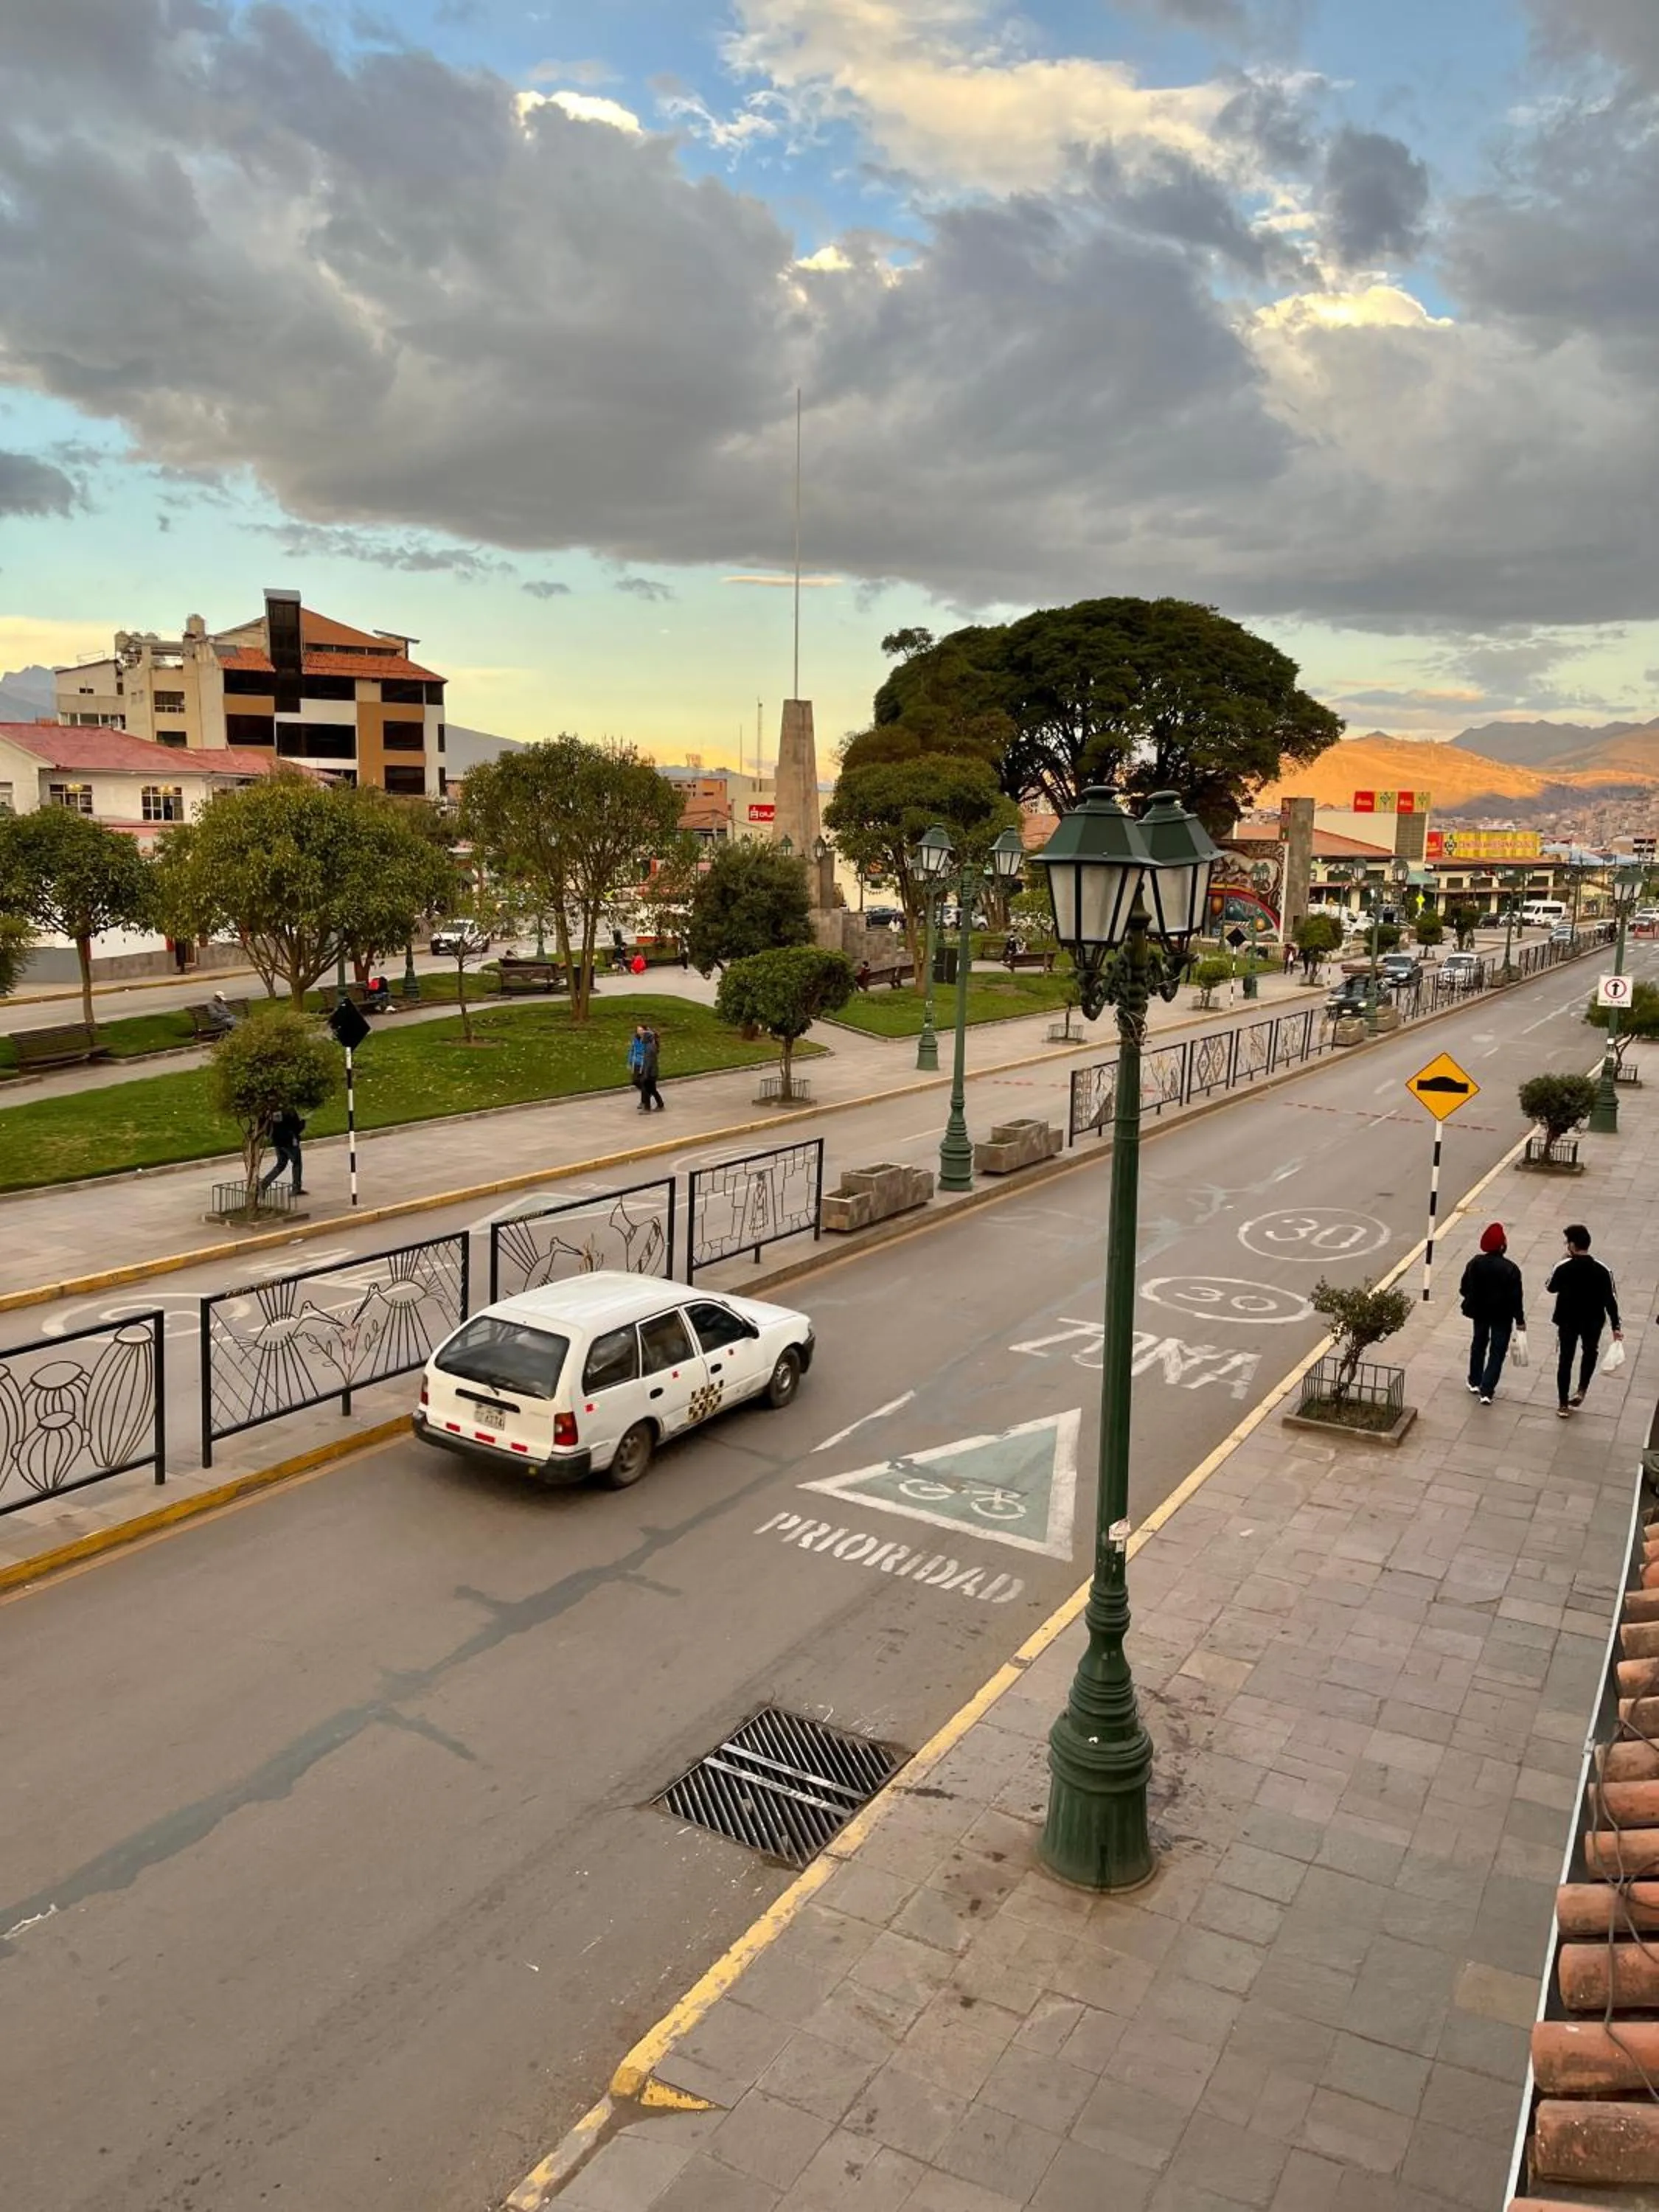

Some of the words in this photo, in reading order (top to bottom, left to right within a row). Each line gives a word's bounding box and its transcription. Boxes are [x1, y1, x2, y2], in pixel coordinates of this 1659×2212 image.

[1266, 1217, 1367, 1249] 30
[1175, 1286, 1278, 1312] 30
[753, 1511, 1026, 1604] PRIORIDAD
